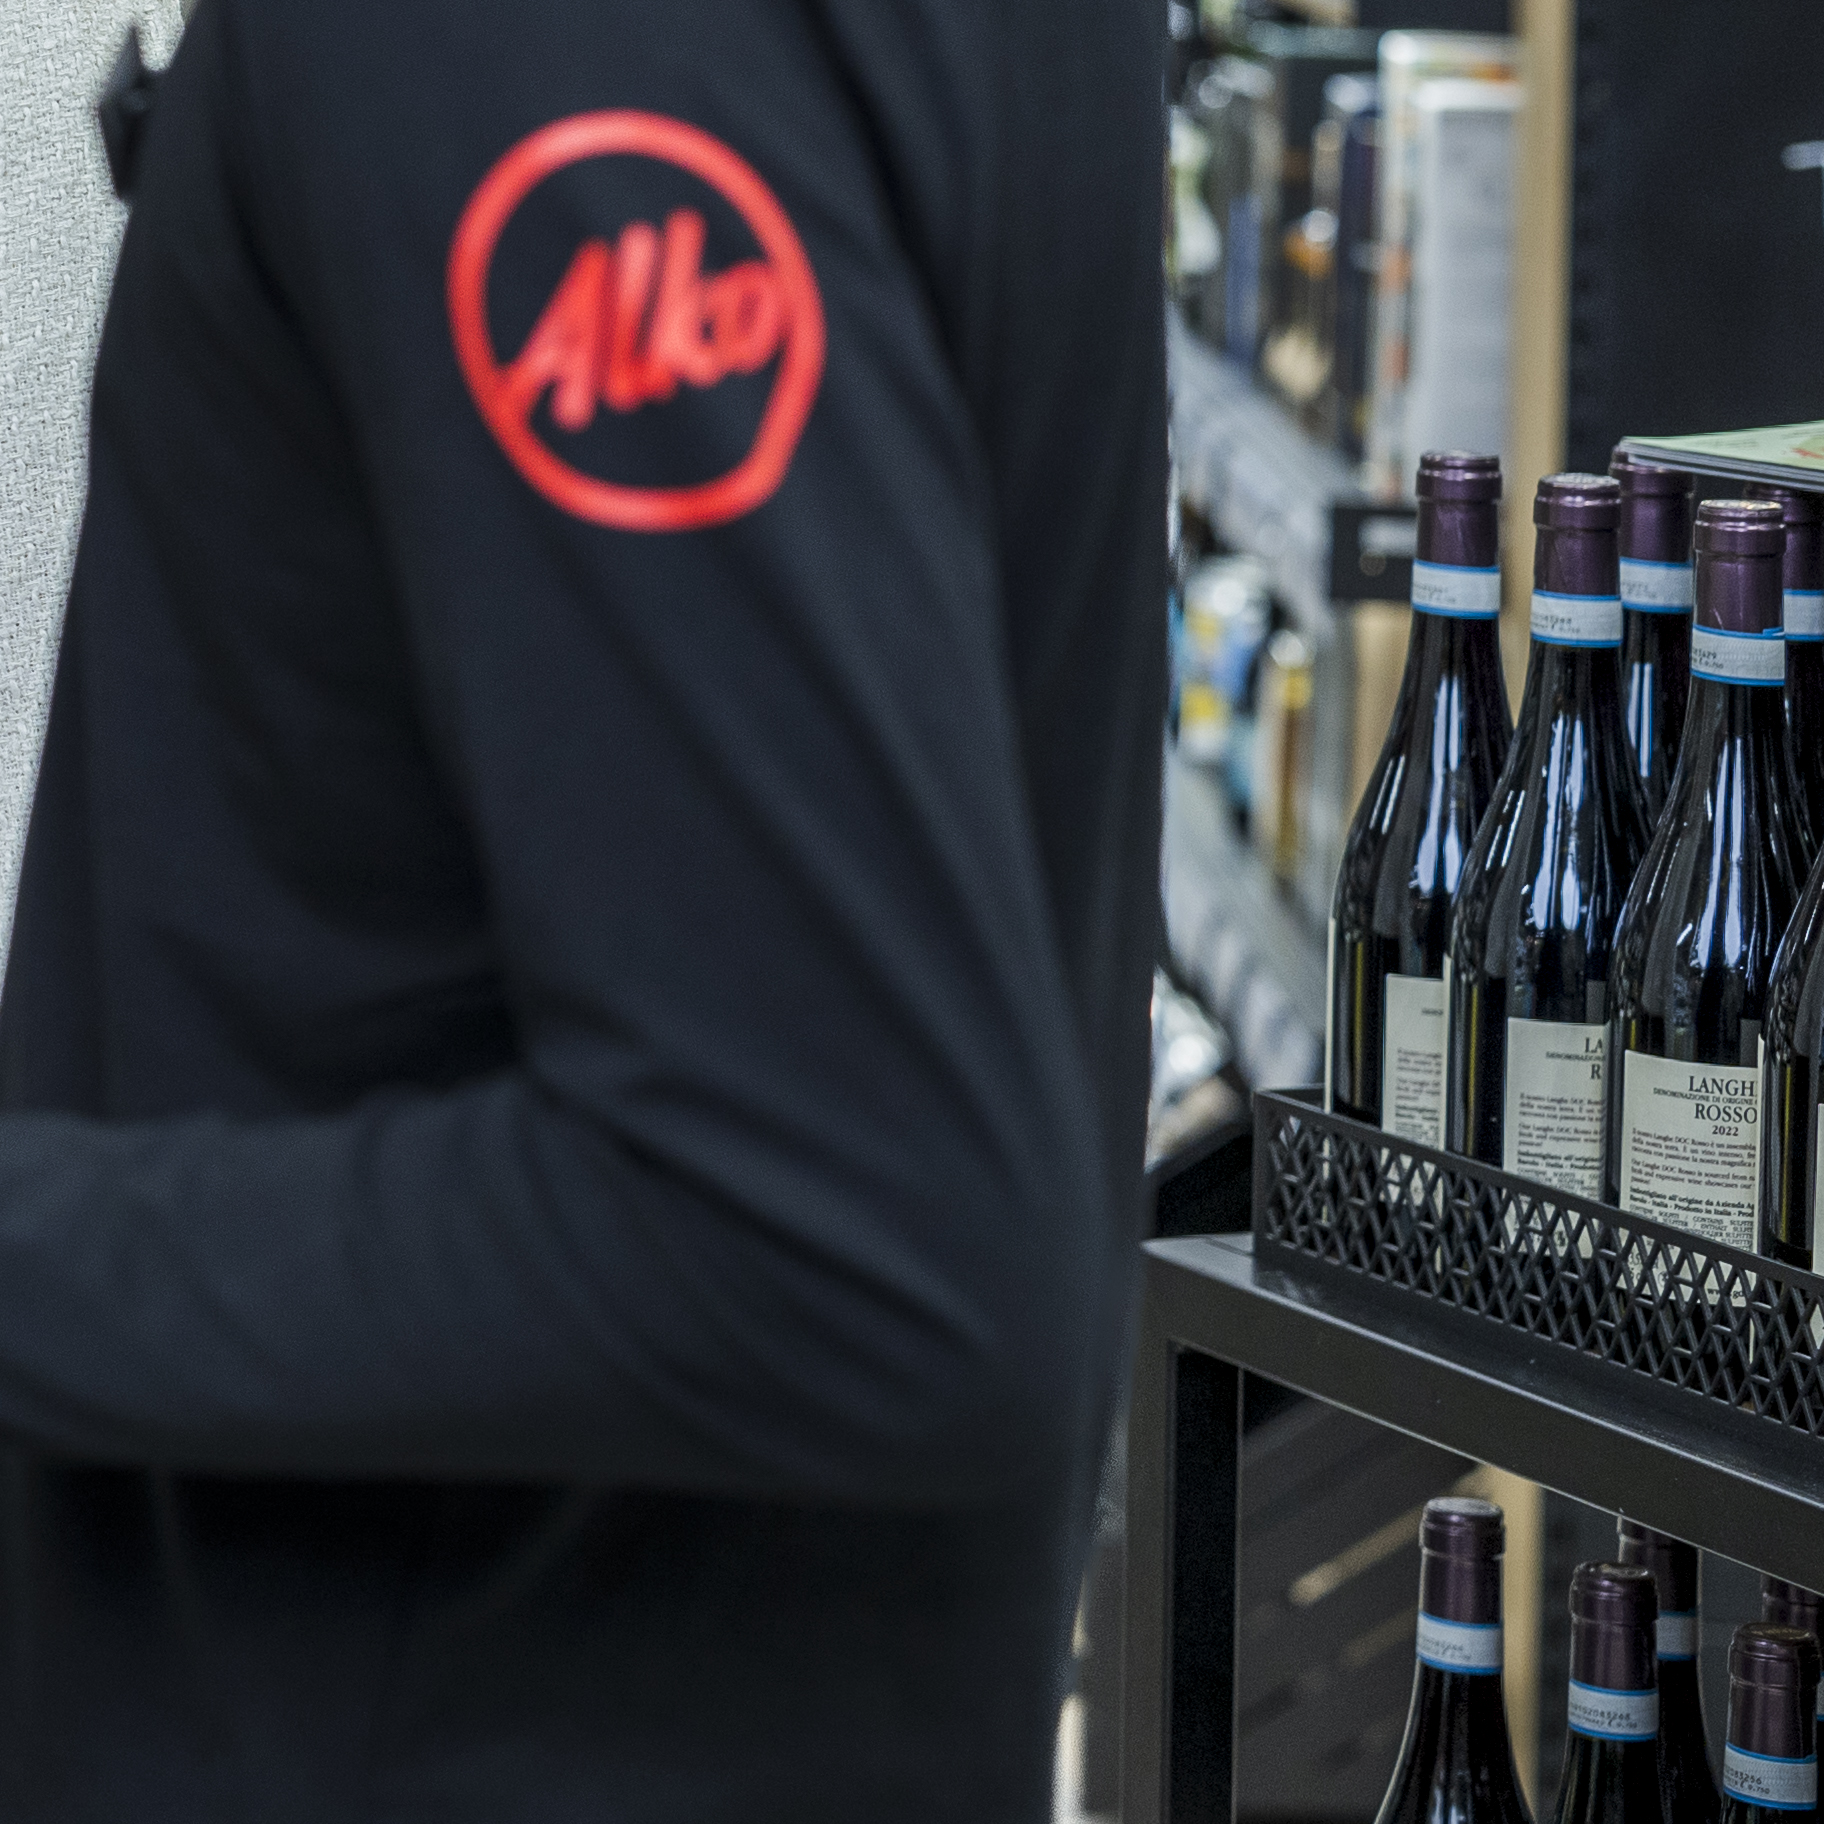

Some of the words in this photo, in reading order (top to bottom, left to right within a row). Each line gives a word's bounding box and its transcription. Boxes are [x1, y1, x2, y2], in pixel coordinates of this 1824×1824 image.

[502, 206, 789, 433] Alko
[1688, 1075, 1757, 1097] LANGH
[1694, 1103, 1757, 1124] ROSSO
[1711, 1125, 1739, 1137] 2022
